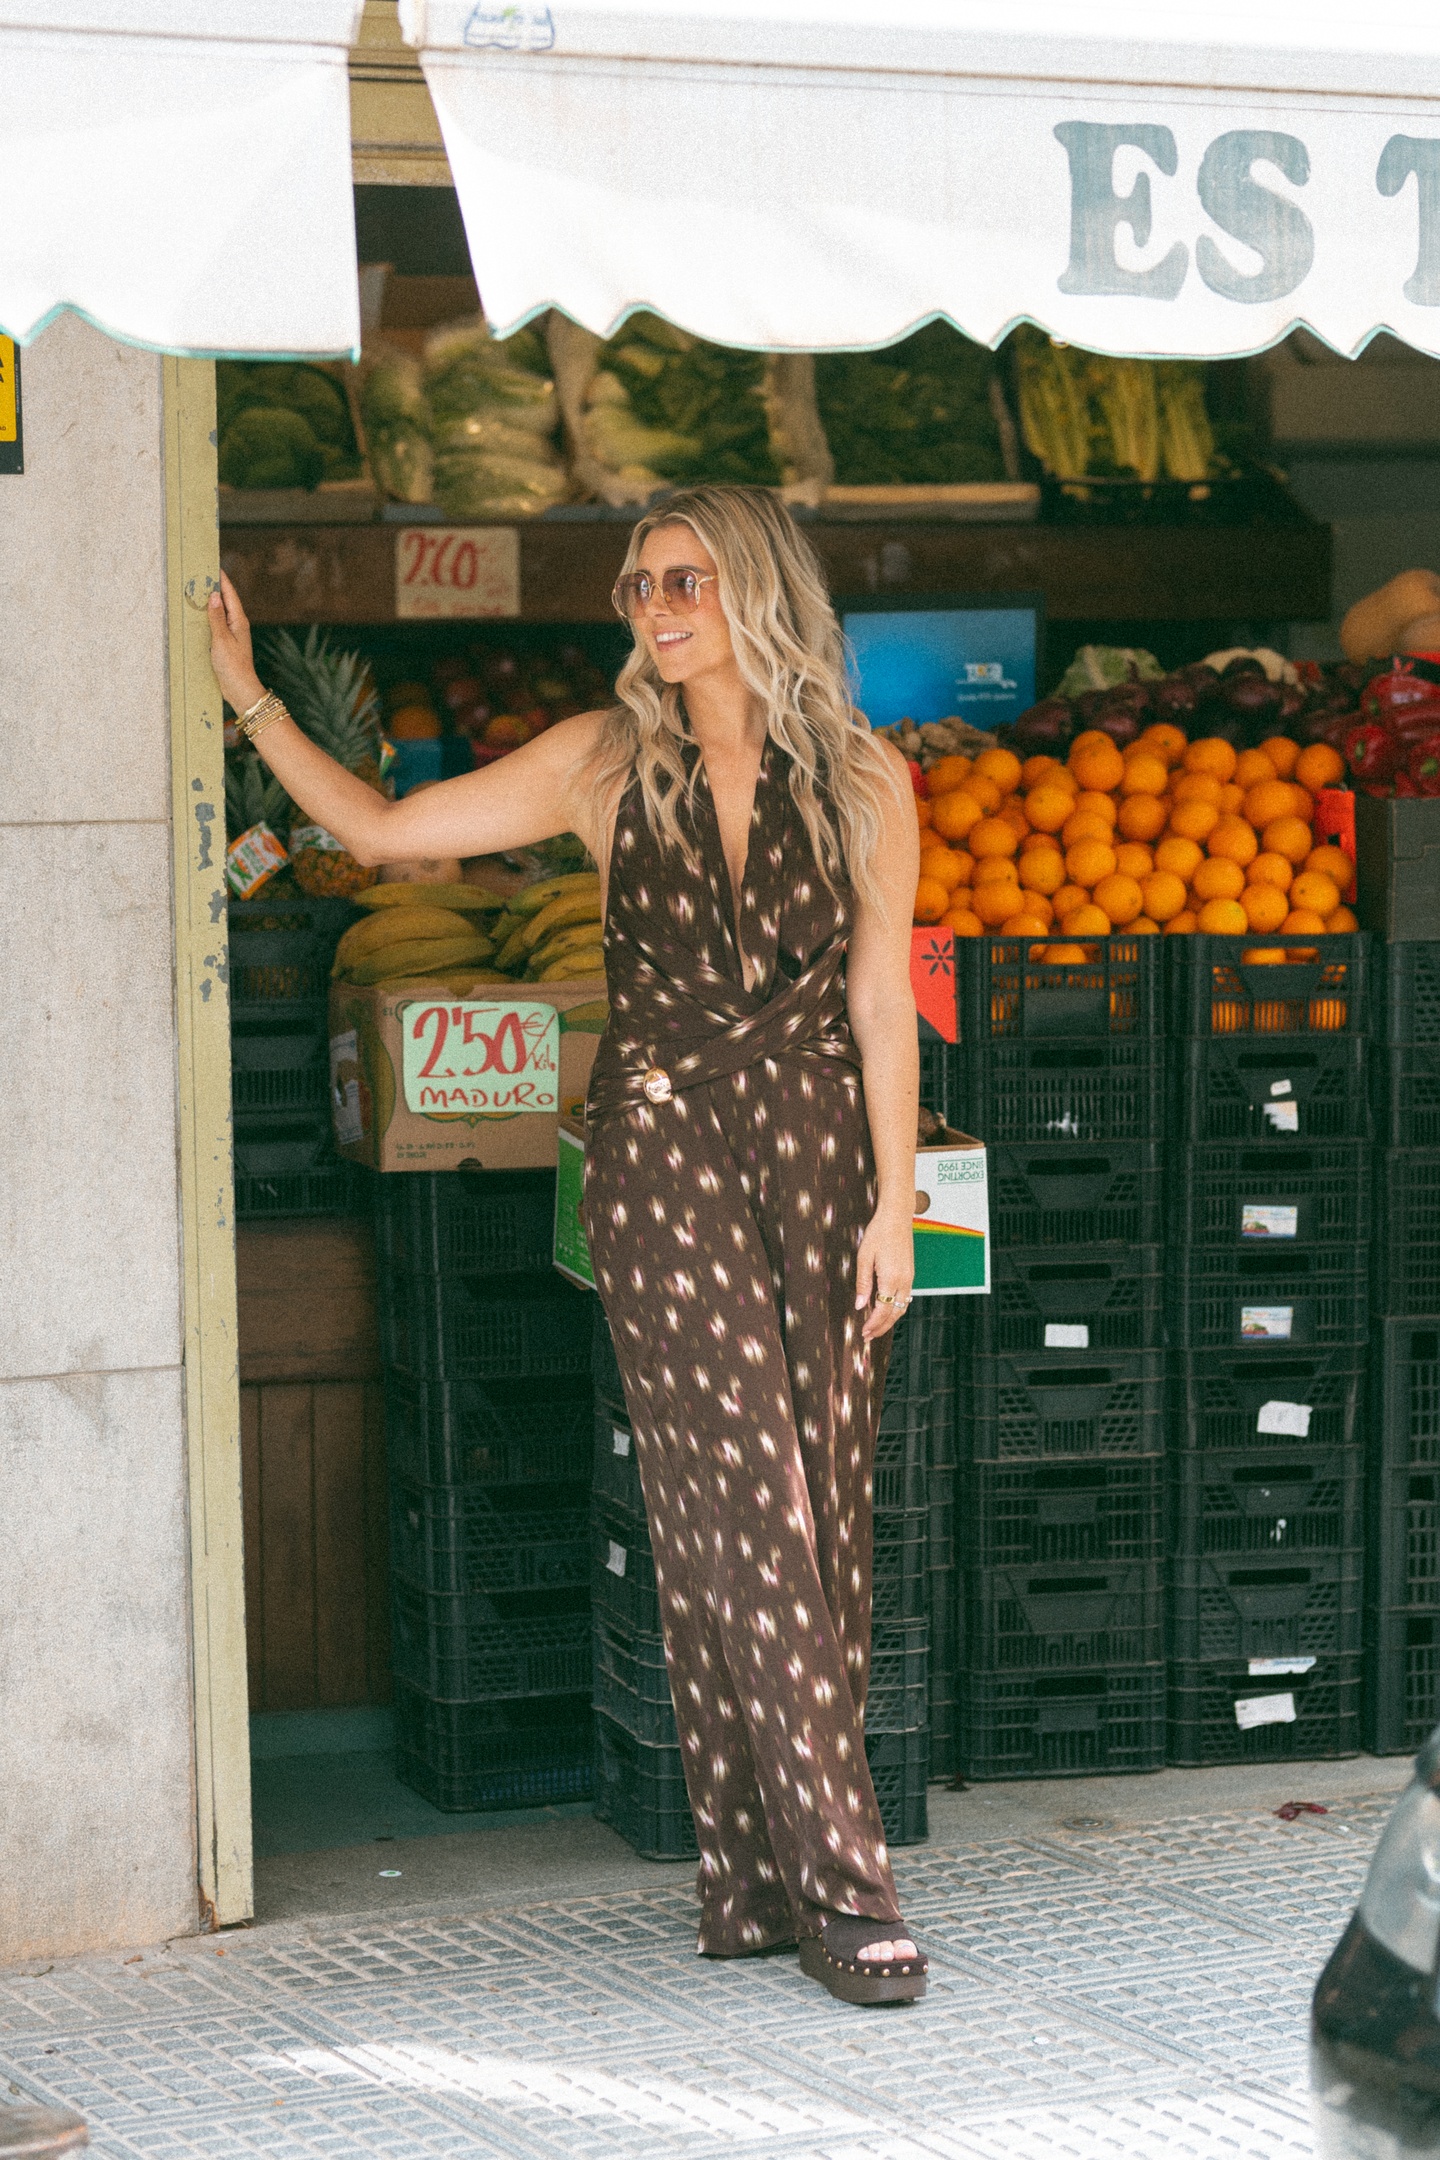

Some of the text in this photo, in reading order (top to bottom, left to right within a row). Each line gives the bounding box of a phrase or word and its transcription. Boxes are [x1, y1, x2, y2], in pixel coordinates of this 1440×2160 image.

[1053, 119, 1315, 304] ES
[420, 1083, 554, 1108] MADURO
[938, 1160, 984, 1172] SINCE 1990
[938, 1170, 984, 1181] EXPORTING
